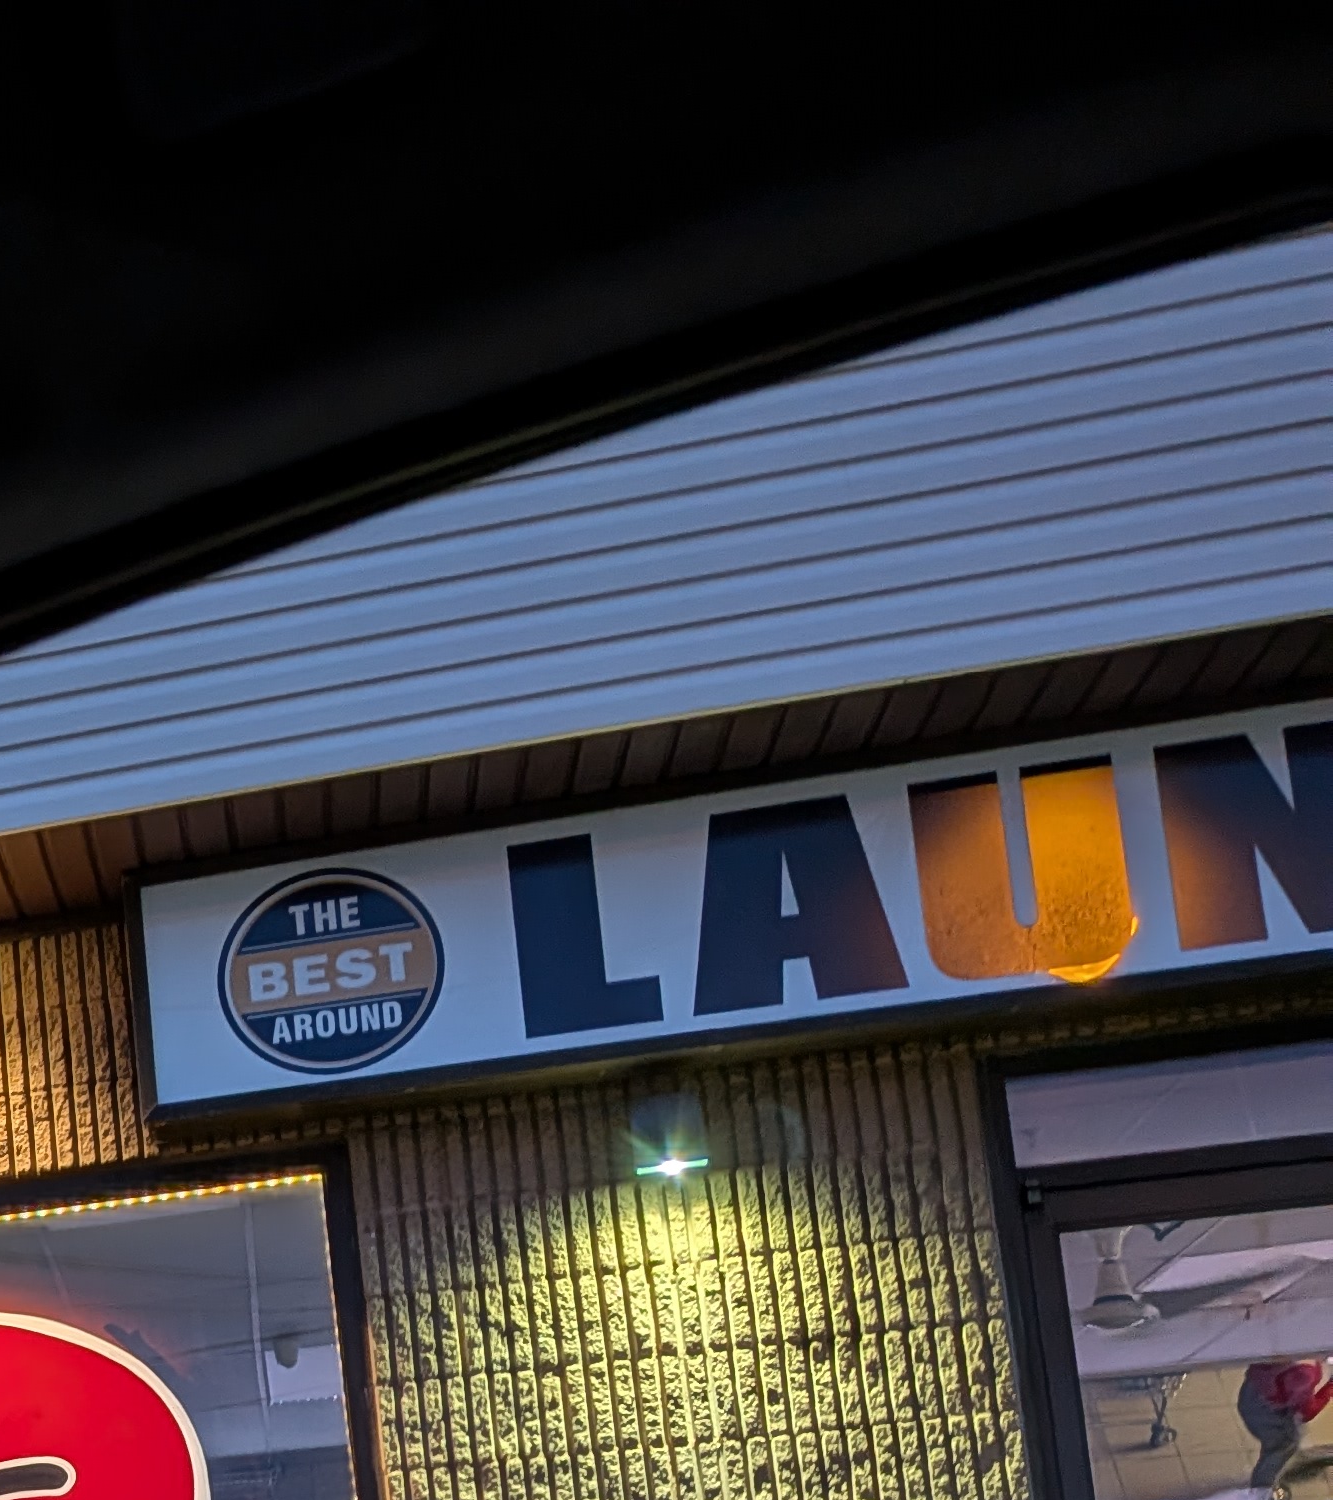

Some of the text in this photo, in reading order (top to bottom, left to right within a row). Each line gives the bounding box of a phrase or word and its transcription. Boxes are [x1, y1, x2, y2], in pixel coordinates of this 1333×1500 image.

[288, 895, 361, 936] THE
[247, 942, 413, 1003] BEST
[272, 1001, 403, 1045] AROUND
